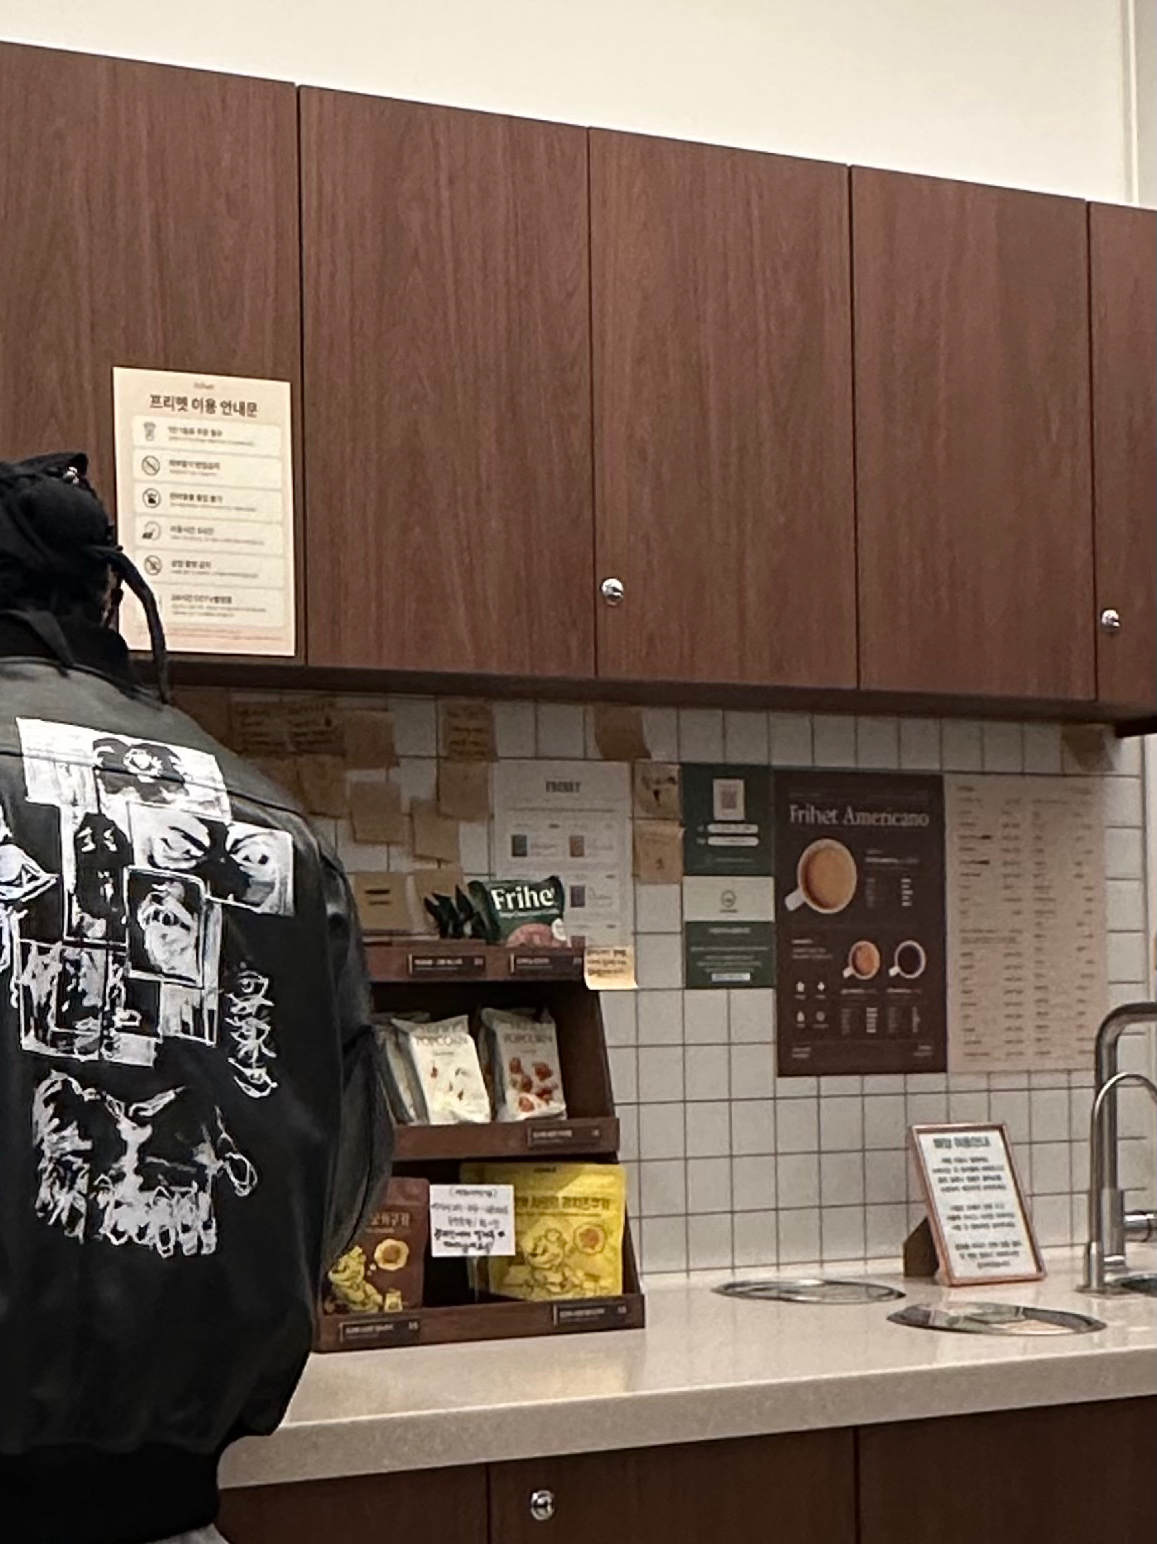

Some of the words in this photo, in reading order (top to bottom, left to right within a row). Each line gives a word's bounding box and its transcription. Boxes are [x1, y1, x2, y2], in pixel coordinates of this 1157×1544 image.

[192, 397, 217, 415] 이용
[220, 399, 258, 418] 안내문
[789, 804, 838, 825] Frihet
[843, 806, 931, 827] Americano
[490, 885, 555, 911] Frihe
[503, 1032, 554, 1044] POPCORN
